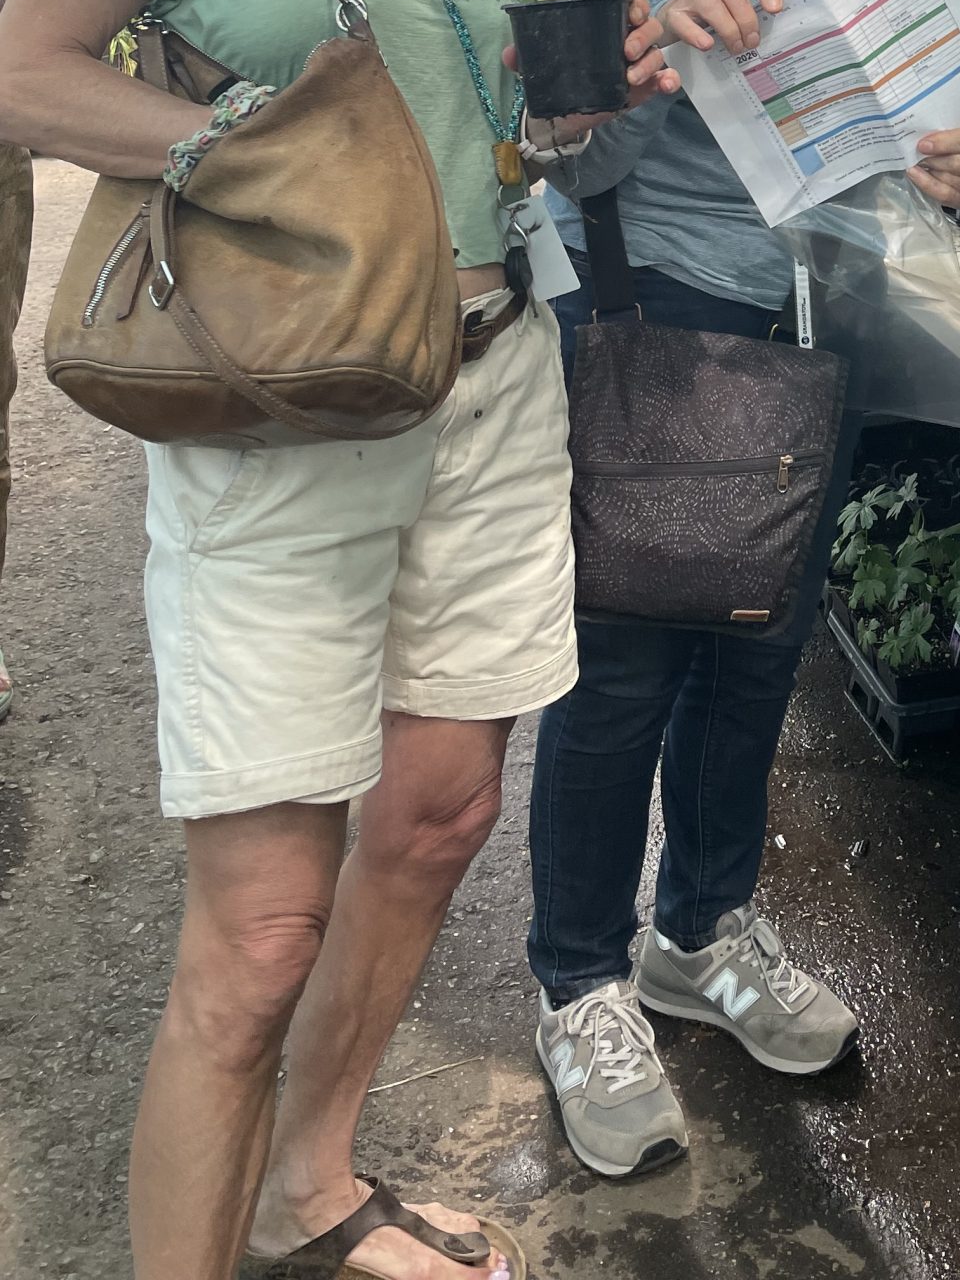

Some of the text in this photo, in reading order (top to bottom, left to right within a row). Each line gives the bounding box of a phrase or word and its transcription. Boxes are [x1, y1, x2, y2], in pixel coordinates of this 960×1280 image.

[736, 49, 758, 65] 2026
[703, 967, 760, 1021] N
[549, 1038, 586, 1101] N
